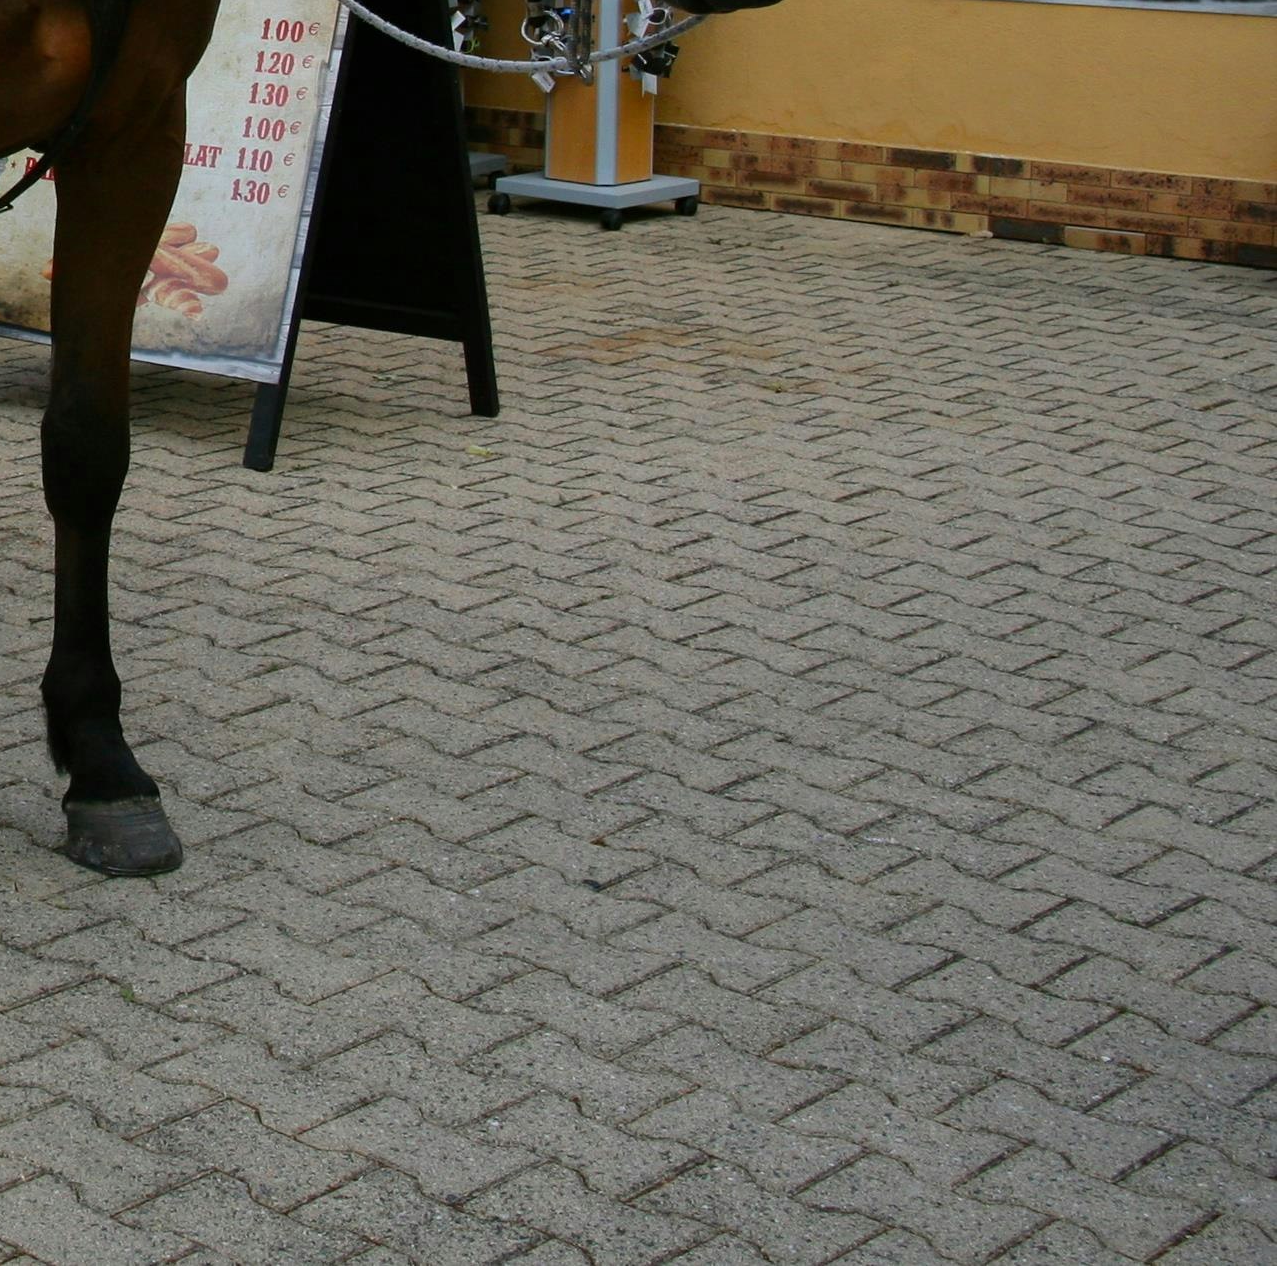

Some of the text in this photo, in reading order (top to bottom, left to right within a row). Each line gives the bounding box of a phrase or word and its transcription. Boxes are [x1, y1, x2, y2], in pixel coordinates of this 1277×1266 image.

[261, 18, 321, 43] 1.00 €
[255, 50, 315, 76] 1.20 €
[248, 82, 309, 107] 1.30 €
[242, 116, 302, 142] 1.00 €
[183, 143, 296, 173] LAT 1.10 €
[230, 178, 290, 205] 1.30 €
